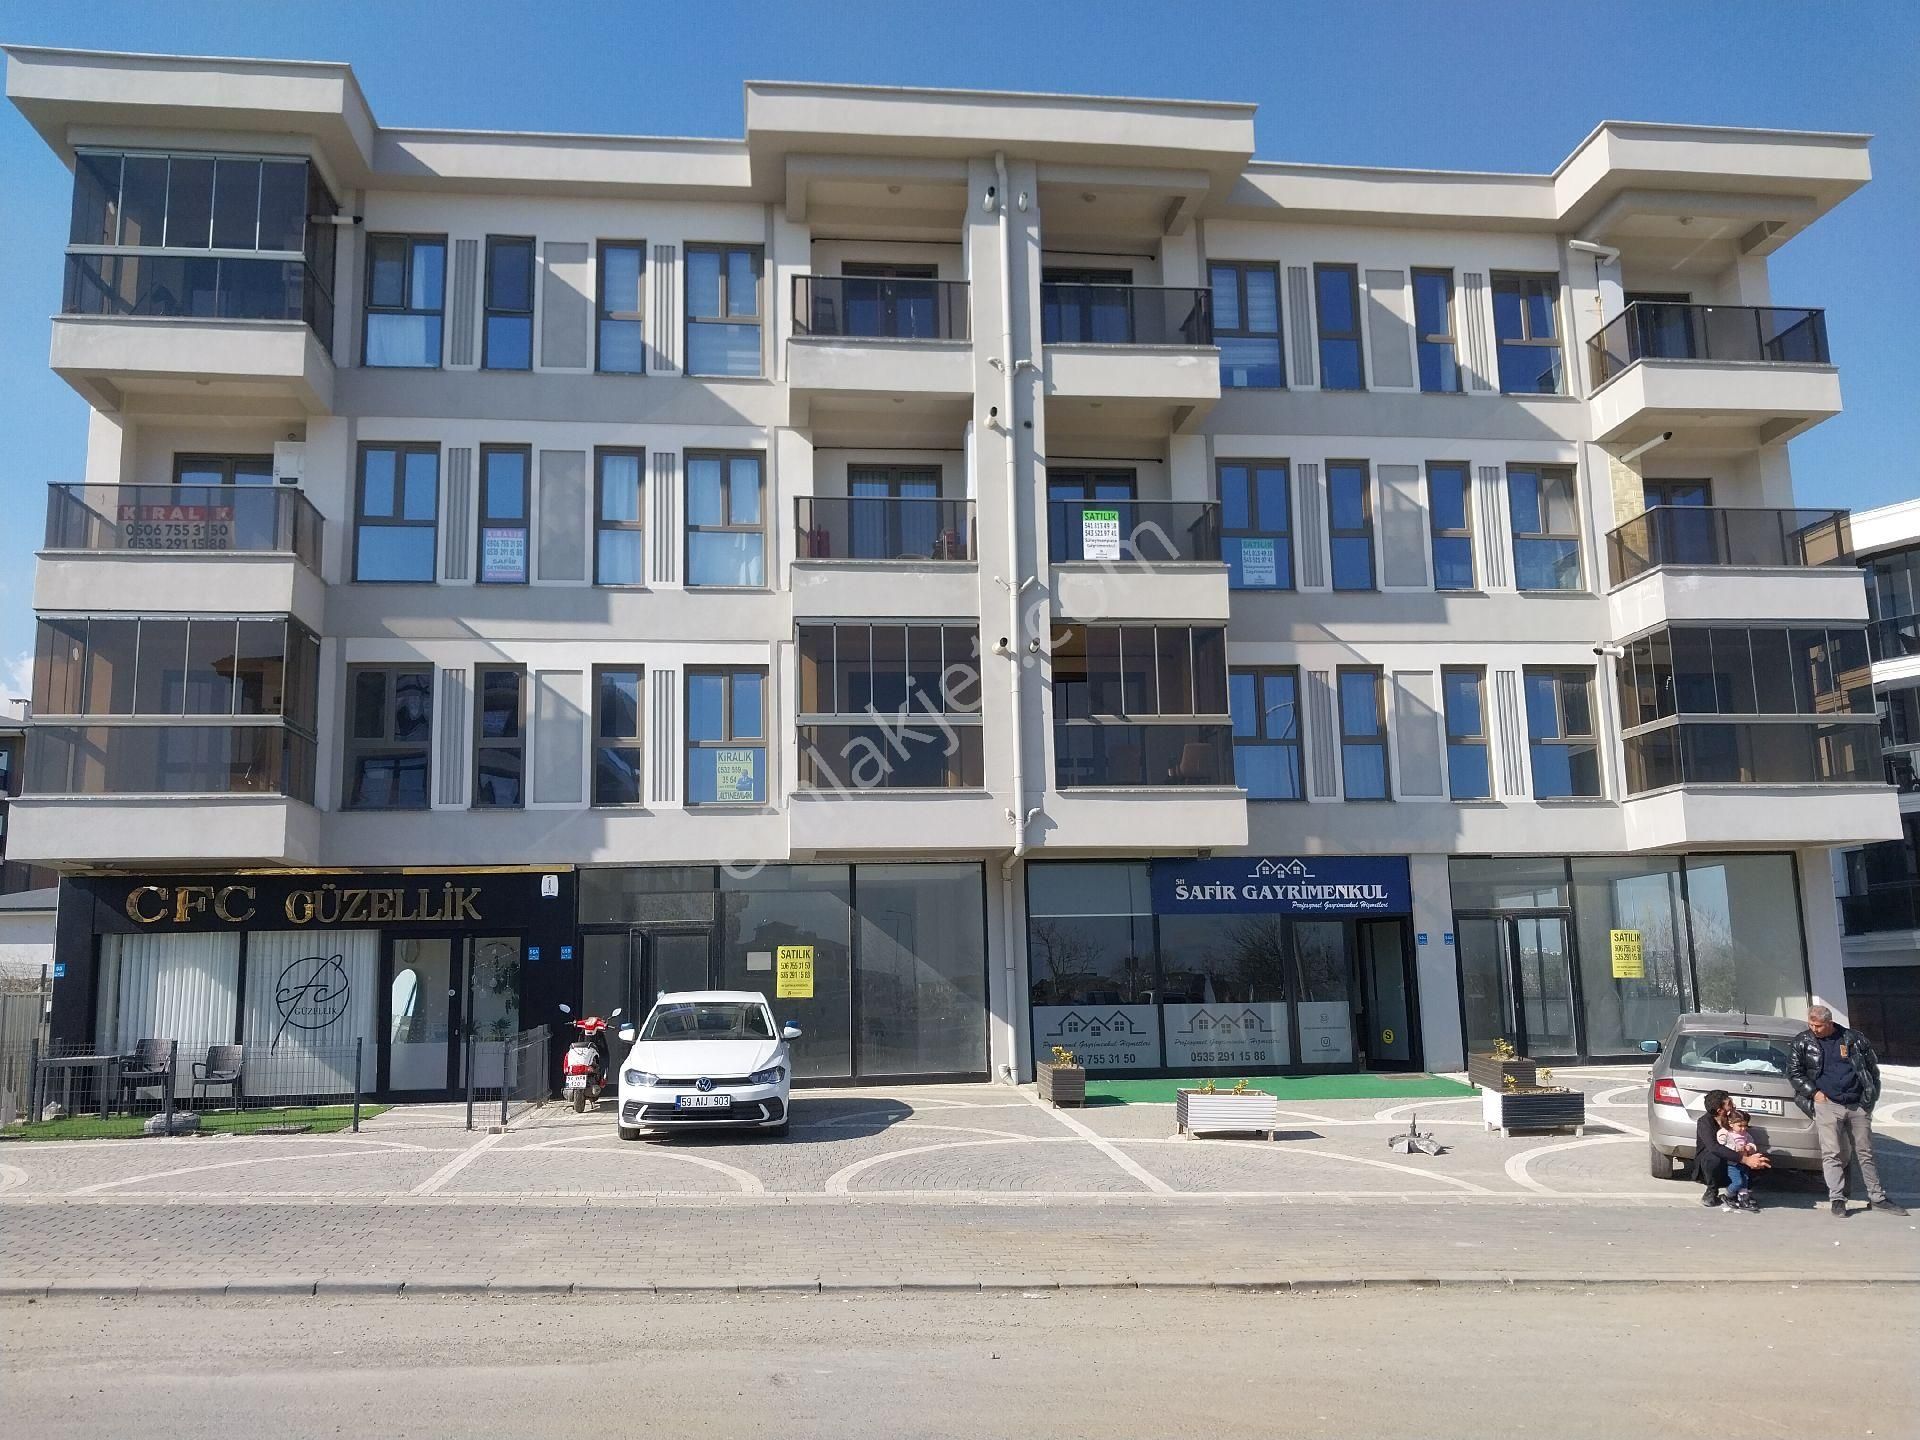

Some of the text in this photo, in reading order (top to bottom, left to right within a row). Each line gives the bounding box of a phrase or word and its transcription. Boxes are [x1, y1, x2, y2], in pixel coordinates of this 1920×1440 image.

[1084, 512, 1117, 521] SATILIK
[126, 524, 162, 536] 0506
[165, 524, 190, 536] 755
[210, 524, 228, 536] 50
[128, 538, 162, 550] 0535
[166, 538, 188, 550] 291
[208, 538, 227, 550] 88
[718, 751, 752, 762] KİRALIK
[1175, 880, 1388, 900] SAFİR GAYRİMENKUL
[125, 885, 256, 923] CFC
[284, 882, 483, 924] GÜZELLİK
[1614, 933, 1641, 942] SATILIK
[780, 950, 810, 960] SATILIK
[294, 1007, 338, 1016] GÜZELLİK
[1088, 1054, 1105, 1064] 755
[1109, 1054, 1120, 1064] 31
[1124, 1054, 1136, 1064] 50
[1190, 1051, 1266, 1062] 0535 291 15 88
[682, 1098, 692, 1106] 59
[714, 1096, 728, 1106] 903
[1740, 1098, 1779, 1110] EJ 311
